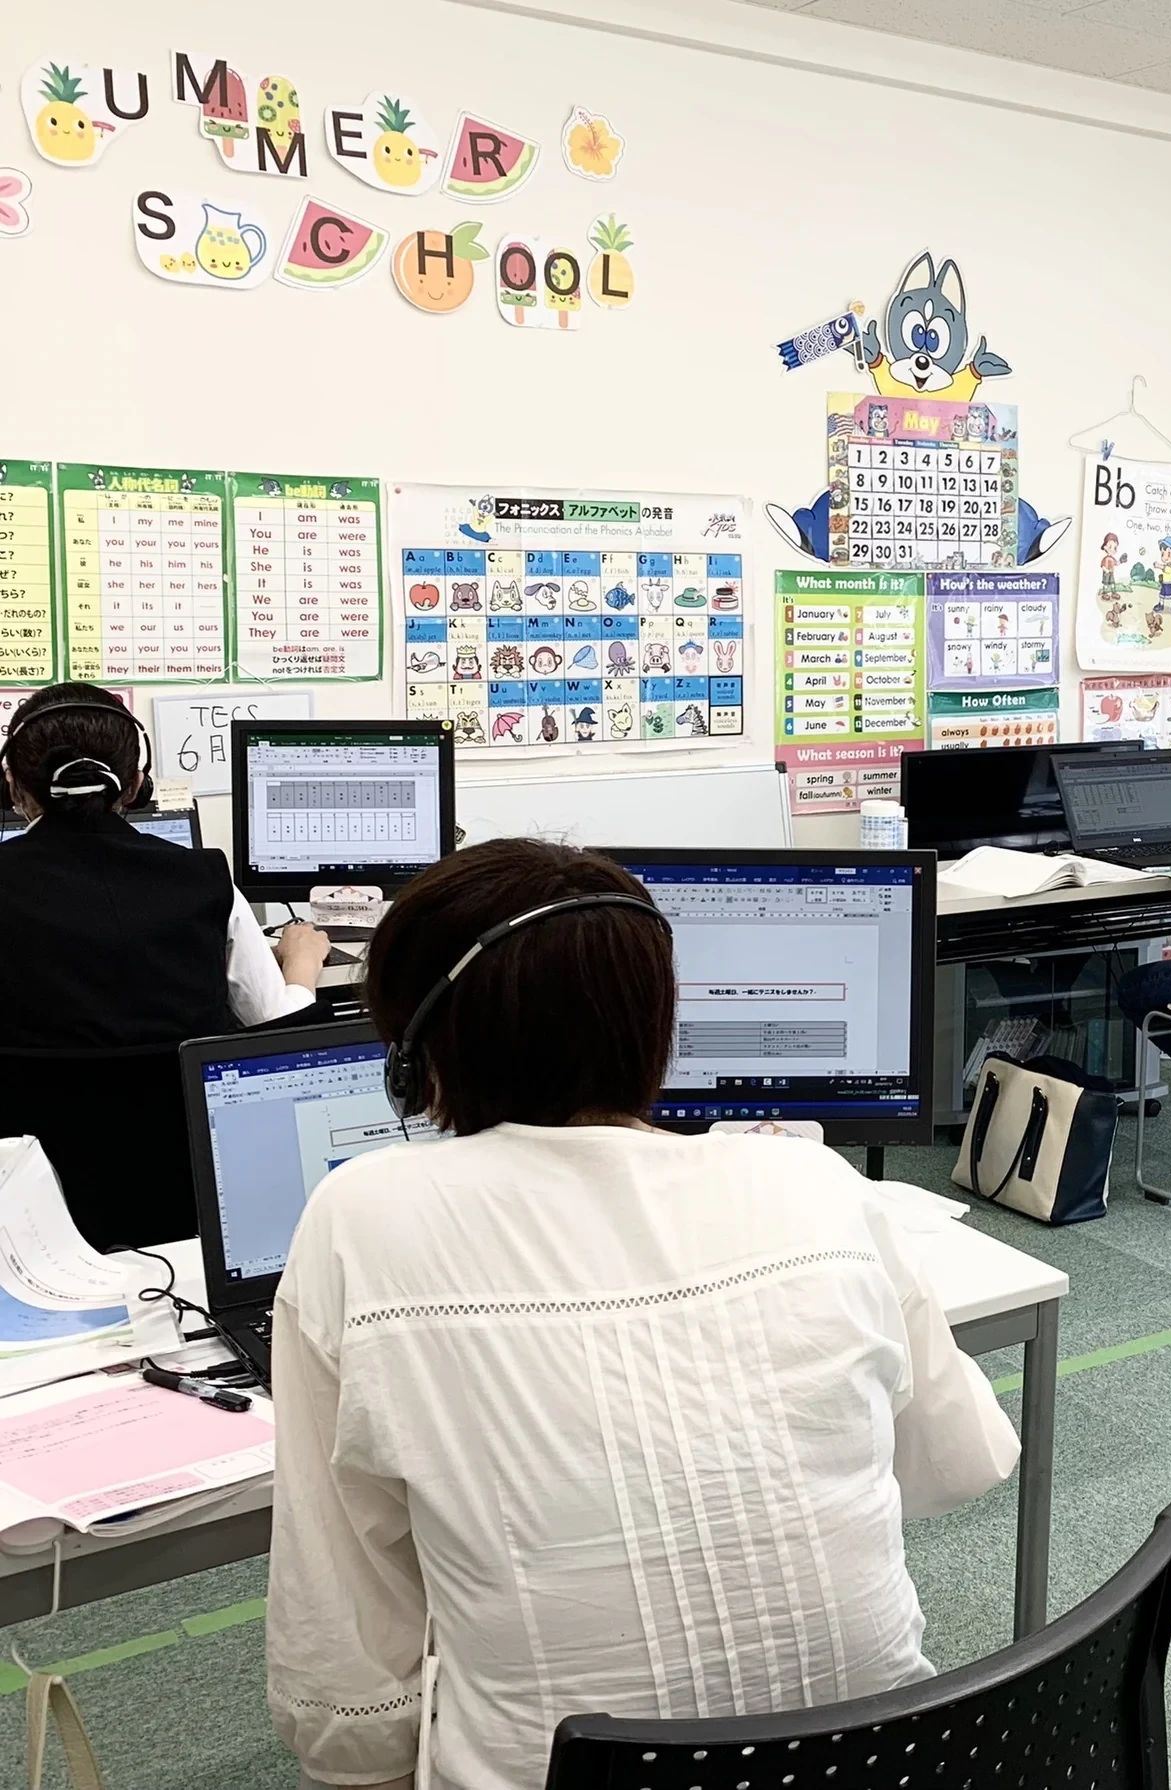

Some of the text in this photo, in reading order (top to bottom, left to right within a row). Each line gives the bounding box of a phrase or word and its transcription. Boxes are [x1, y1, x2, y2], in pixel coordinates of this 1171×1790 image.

[136, 190, 630, 299] SCHOOL
[904, 410, 939, 436] May
[879, 451, 995, 469] 2 3 4 5 6 7
[856, 474, 998, 492] 8 9 10 11 12 13 14
[1095, 464, 1135, 509] Bb
[1145, 485, 1167, 496] Catch
[854, 498, 997, 514] 15 16 17 18 19 20 21
[1145, 503, 1167, 513] Throw
[138, 518, 153, 527] my
[168, 518, 184, 526] me
[298, 514, 360, 524] am was
[250, 529, 366, 541] You are were
[495, 522, 510, 533] The
[585, 524, 598, 535] the
[601, 525, 632, 536] Phonics
[635, 526, 672, 538] Alphabet
[106, 538, 218, 549] you your you yours
[253, 545, 360, 556] He is was
[852, 544, 912, 559] 29 30 31
[200, 560, 213, 569] his
[251, 562, 361, 572] She is was
[258, 578, 265, 588] It
[304, 579, 312, 588] is
[796, 576, 904, 590] What month is it?
[940, 579, 1046, 590] How's the weather?
[253, 595, 271, 604] We
[299, 596, 318, 605] are
[252, 612, 368, 621] You are were
[798, 610, 834, 619] January
[876, 610, 891, 618] July
[249, 628, 369, 639] They are were
[797, 632, 835, 642] February
[869, 632, 897, 642] August
[801, 654, 831, 663] March
[865, 654, 906, 663] September
[108, 665, 128, 674] they
[196, 664, 222, 672] theirs
[805, 677, 826, 686] April
[866, 676, 900, 684] October
[805, 699, 825, 708] May
[865, 696, 906, 705] November
[962, 695, 1026, 707] How Often
[865, 718, 906, 727] December
[942, 728, 969, 736] always
[797, 746, 904, 761] What season is it?
[807, 774, 834, 785] spring
[864, 771, 897, 779] summer
